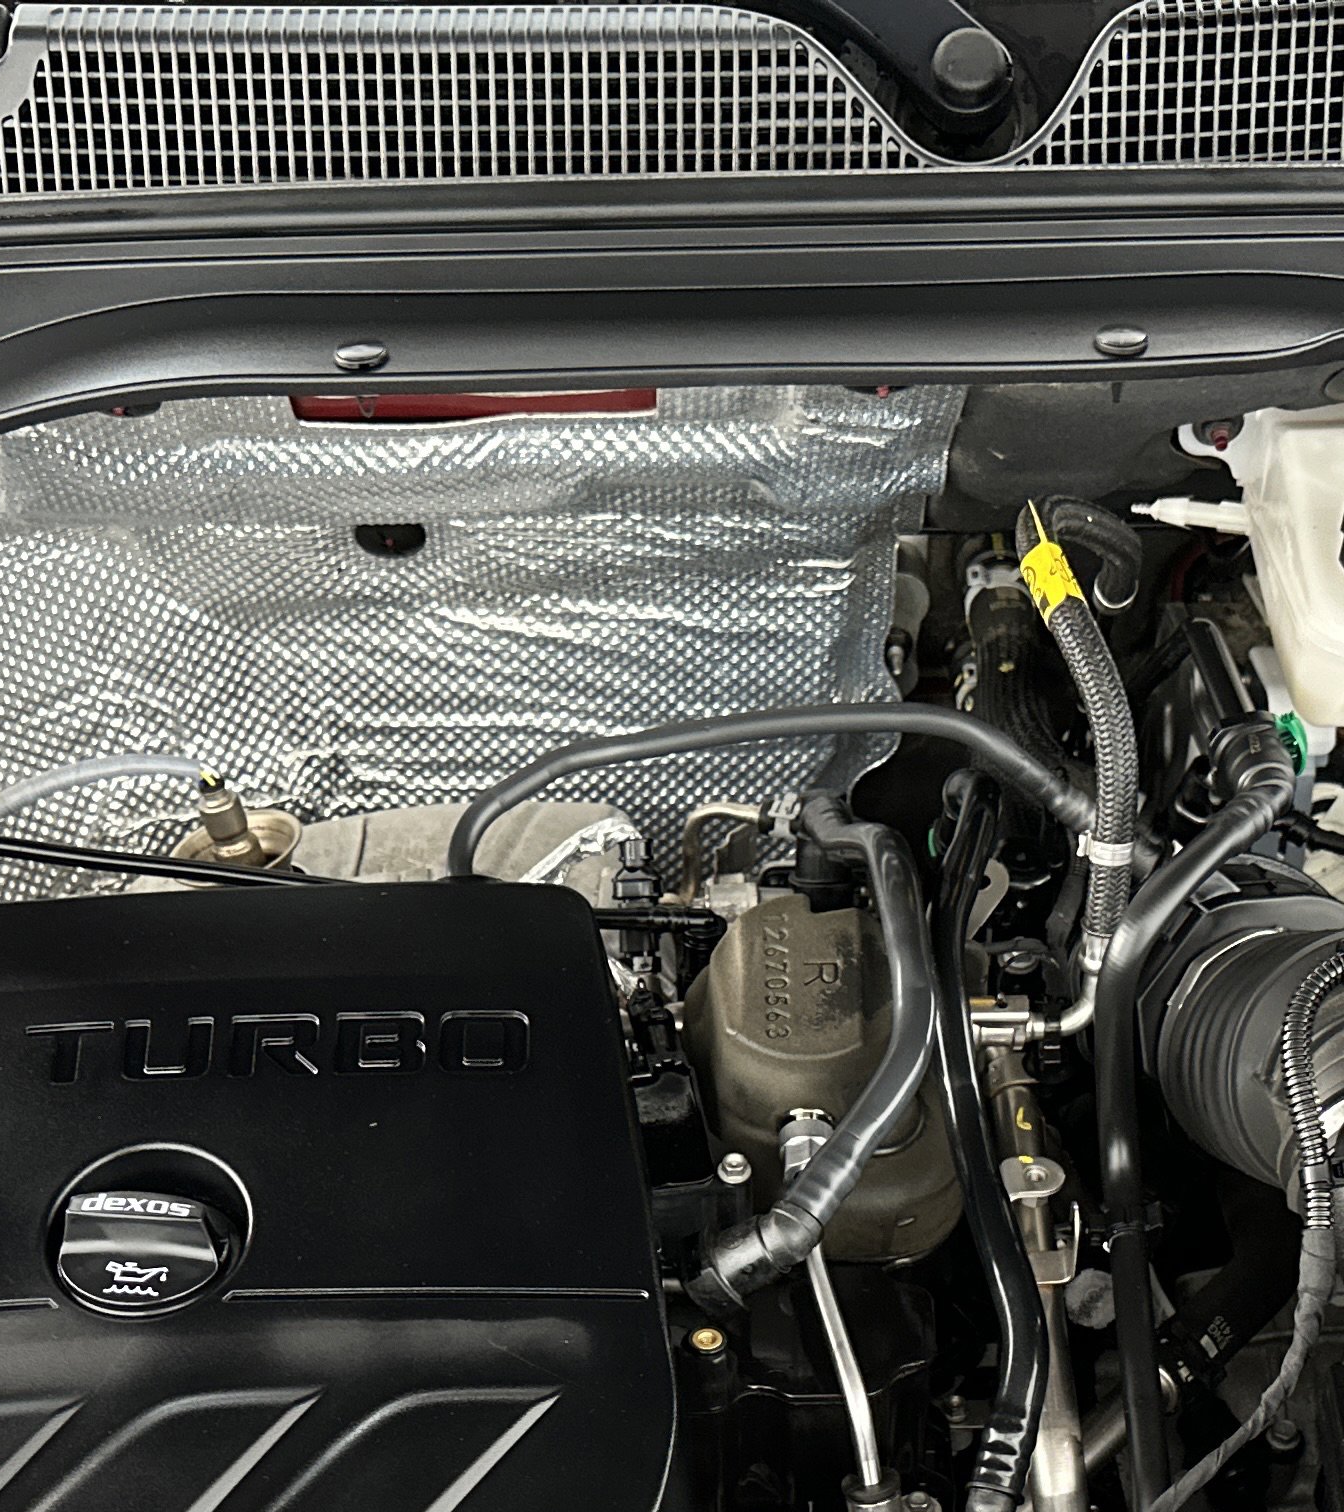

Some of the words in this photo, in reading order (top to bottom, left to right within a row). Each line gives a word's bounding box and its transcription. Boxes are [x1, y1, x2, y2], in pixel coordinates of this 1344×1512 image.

[762, 912, 792, 1041] 12670563
[803, 960, 842, 987] R
[26, 1009, 532, 1086] TURBO
[81, 1193, 193, 1217] dexos
